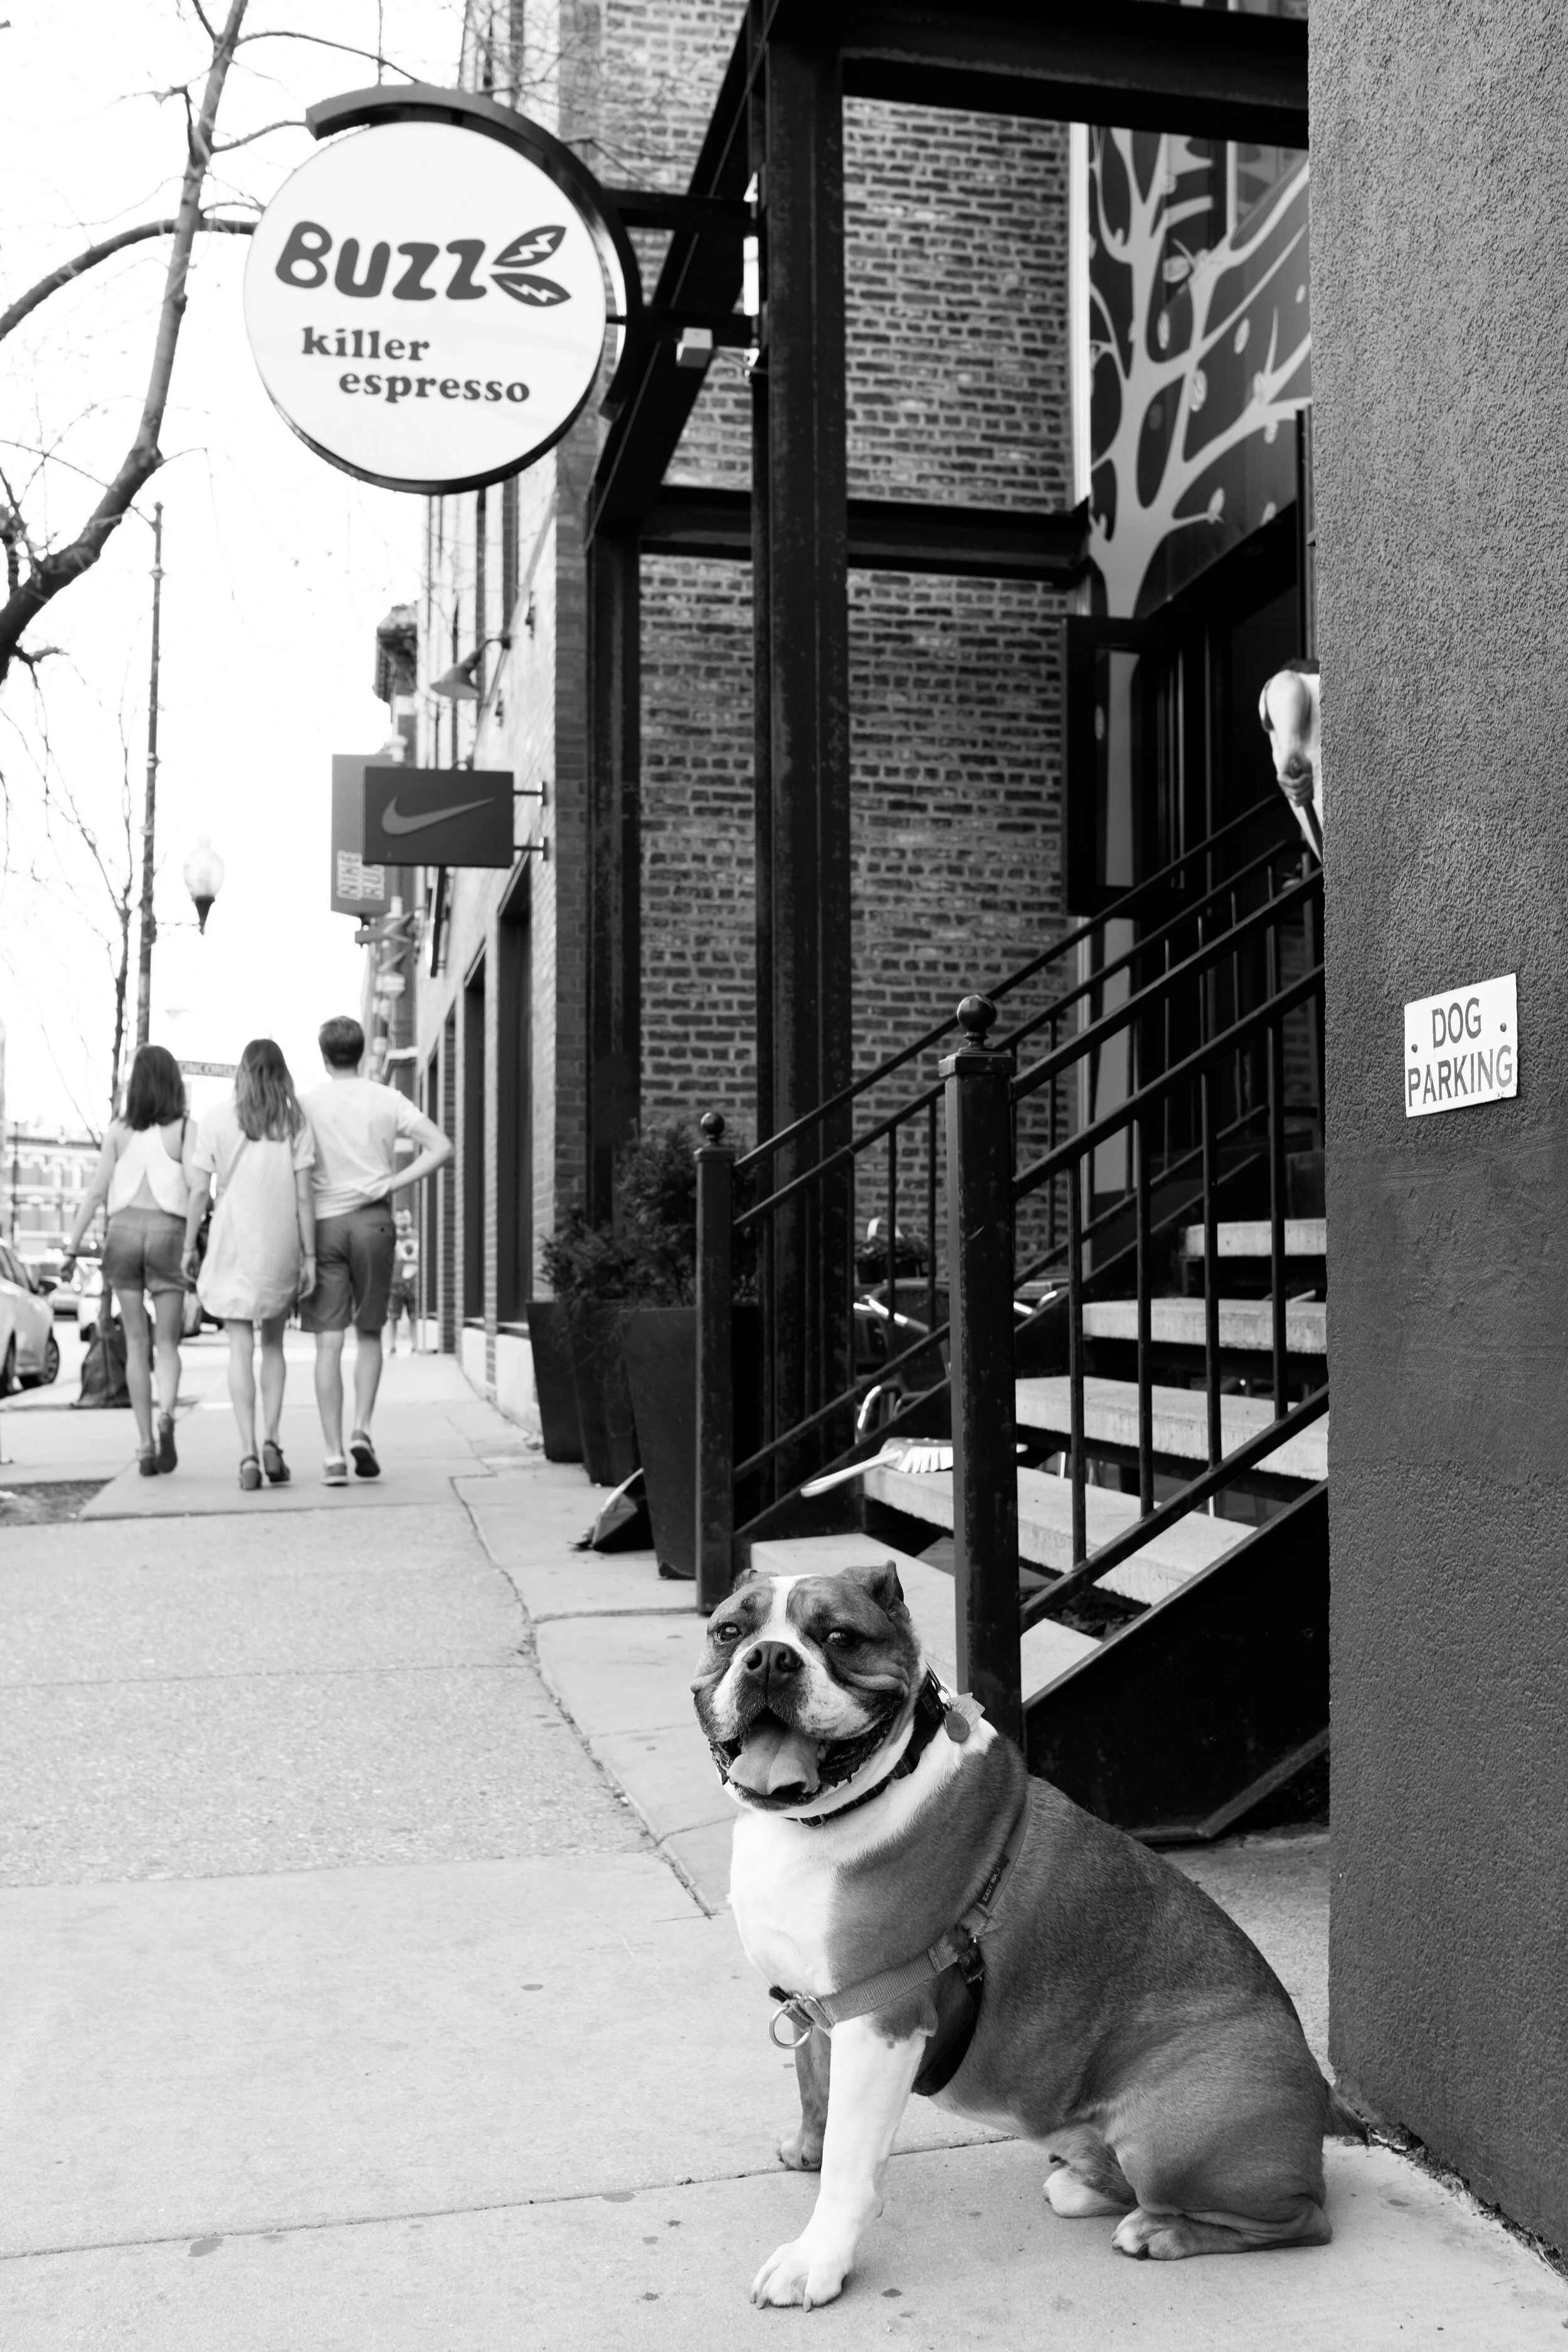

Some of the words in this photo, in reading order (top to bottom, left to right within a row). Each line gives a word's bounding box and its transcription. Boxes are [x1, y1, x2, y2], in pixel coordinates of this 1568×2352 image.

[302, 326, 430, 361] killer
[339, 372, 530, 403] espresso
[1431, 997, 1482, 1049] DOG
[1407, 1044, 1513, 1108] PARKING
[982, 1883, 993, 1902] EASY
